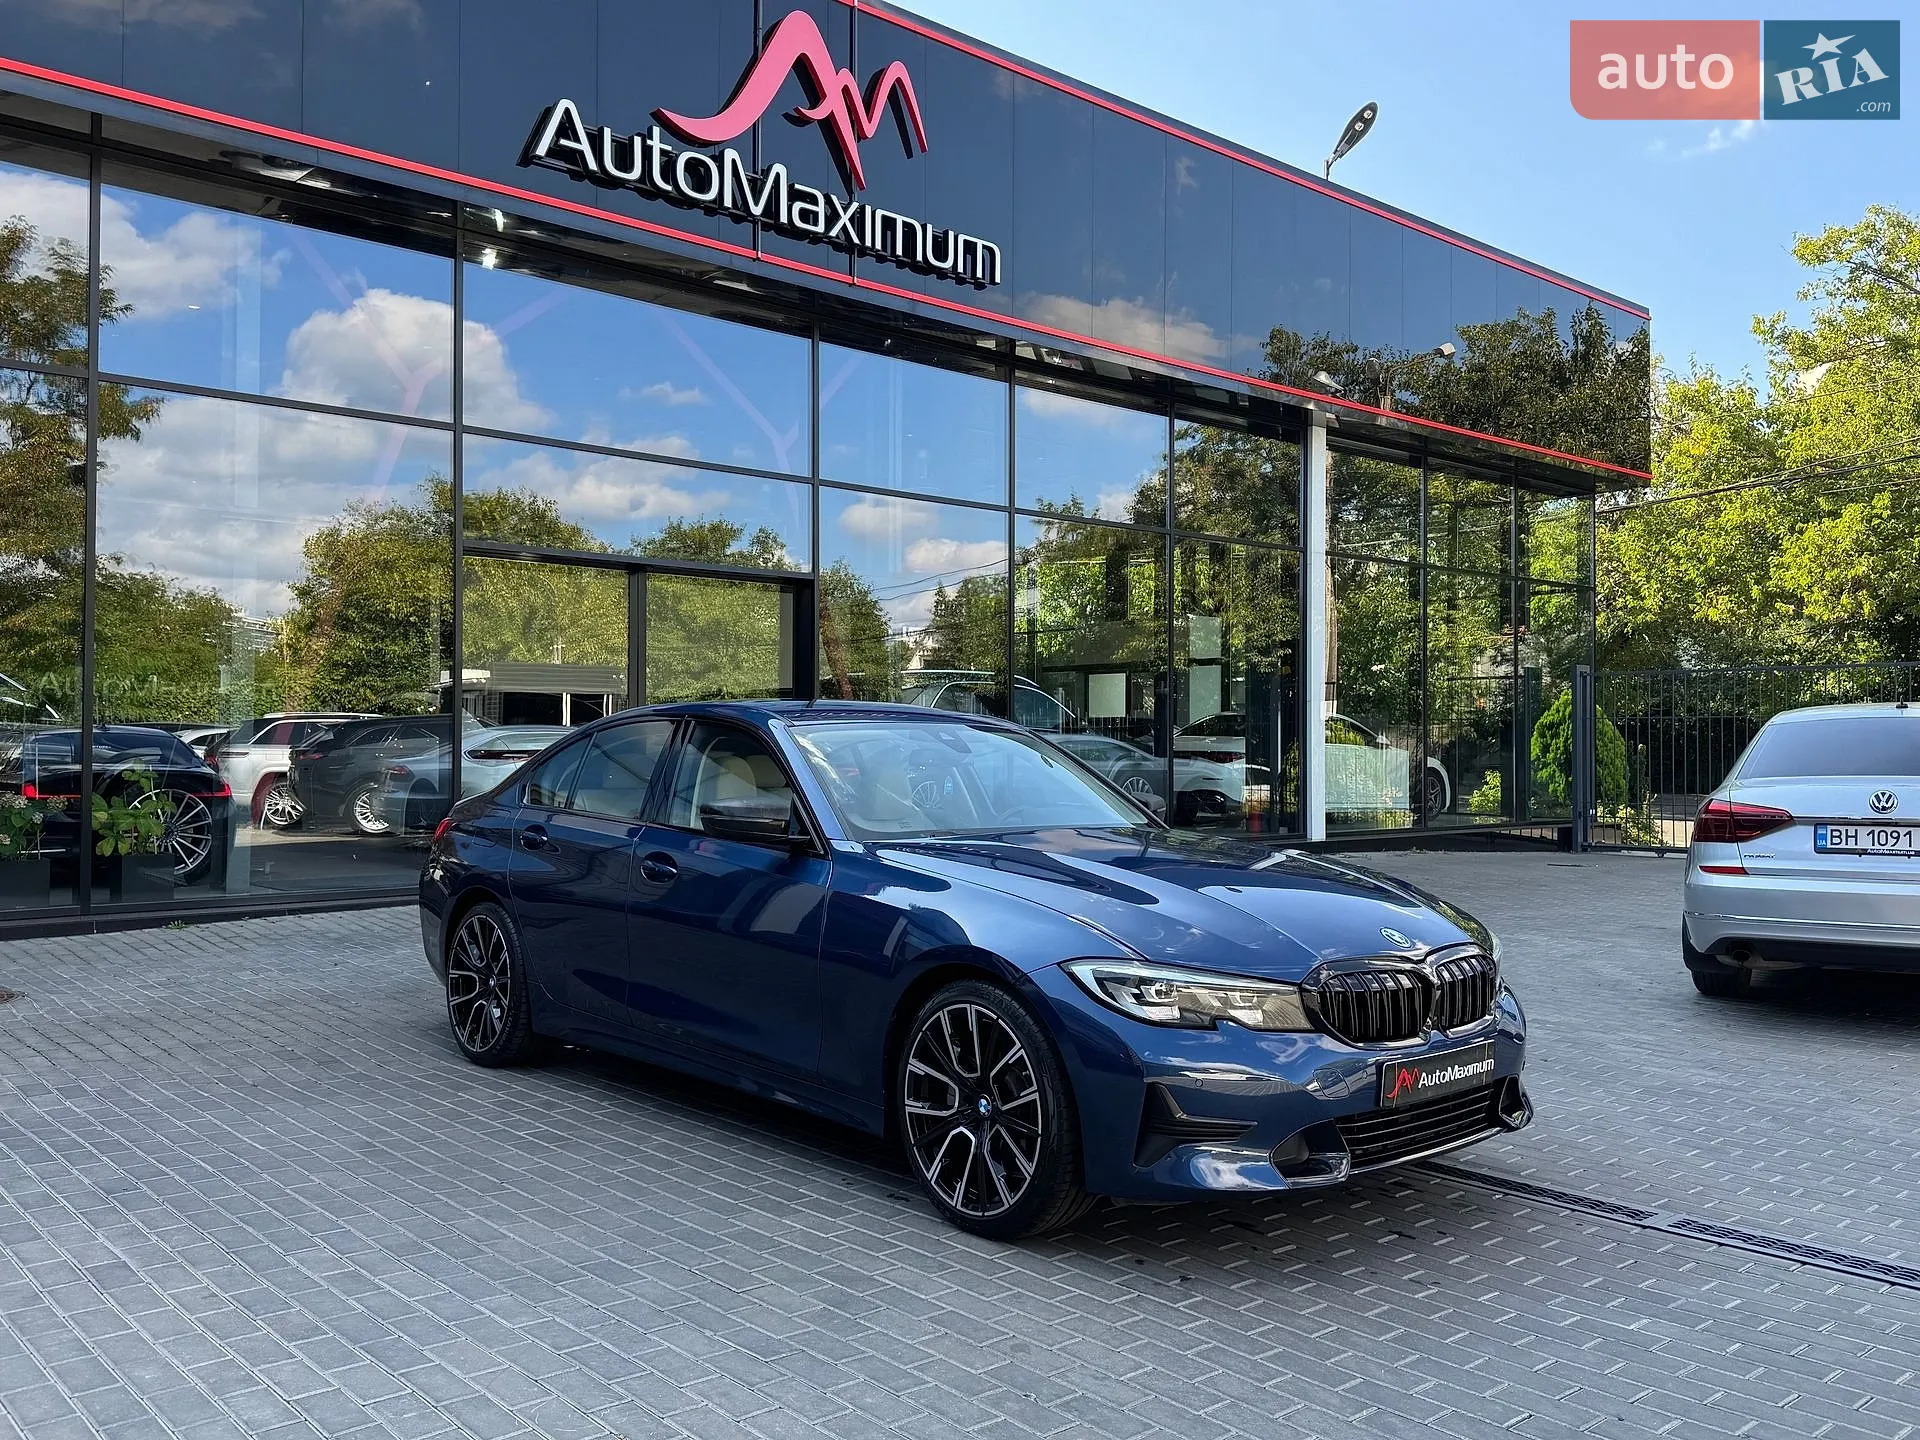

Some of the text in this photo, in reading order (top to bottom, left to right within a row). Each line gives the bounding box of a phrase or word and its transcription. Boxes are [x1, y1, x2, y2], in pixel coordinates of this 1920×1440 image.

[534, 98, 1001, 286] AutoMaximum
[1830, 828, 1913, 848] BH 1091
[1418, 1058, 1495, 1089] AutoMaximum
